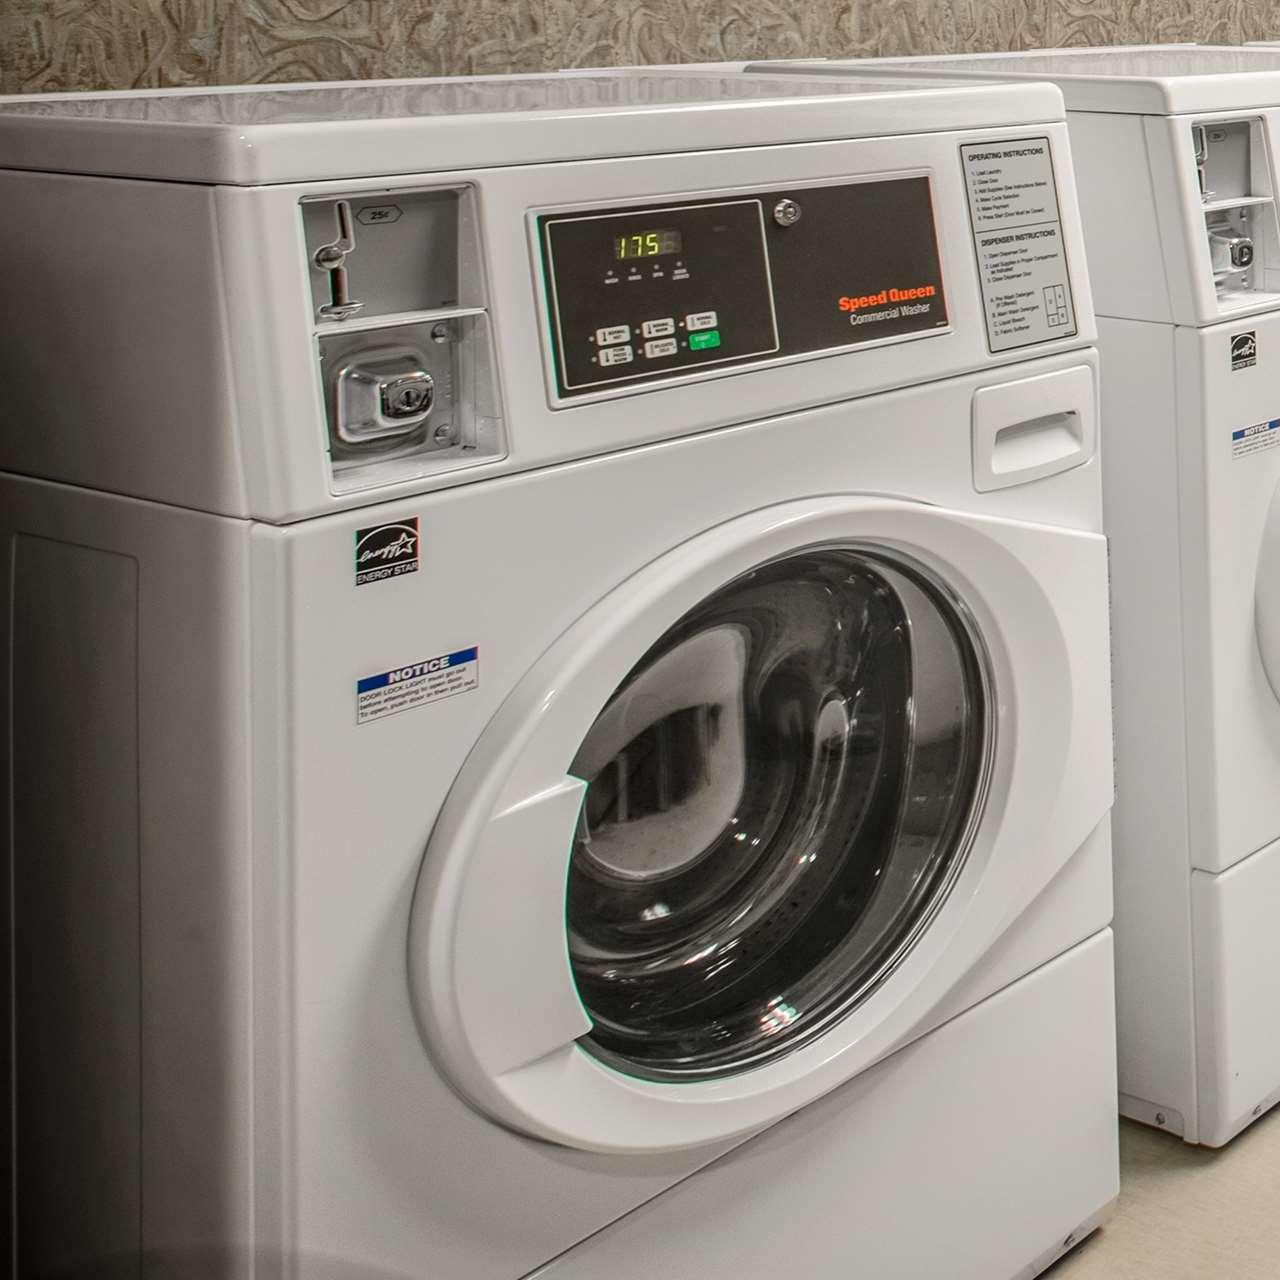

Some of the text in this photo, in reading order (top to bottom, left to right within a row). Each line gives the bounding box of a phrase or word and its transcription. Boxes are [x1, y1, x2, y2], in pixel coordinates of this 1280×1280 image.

[969, 148, 1044, 161] OPERATING INSTRUCTIONS
[620, 234, 659, 258] 175
[981, 230, 1056, 246] DISPENSER INSTRUCTIONS
[839, 285, 935, 312] Speed Queen
[850, 303, 930, 325] Commercial Washer
[357, 562, 417, 584] ENERGY STAR
[388, 657, 450, 683] NOTICE
[360, 692, 382, 702] DOOR
[383, 685, 403, 696] LOCK
[405, 679, 426, 689] LIGHT
